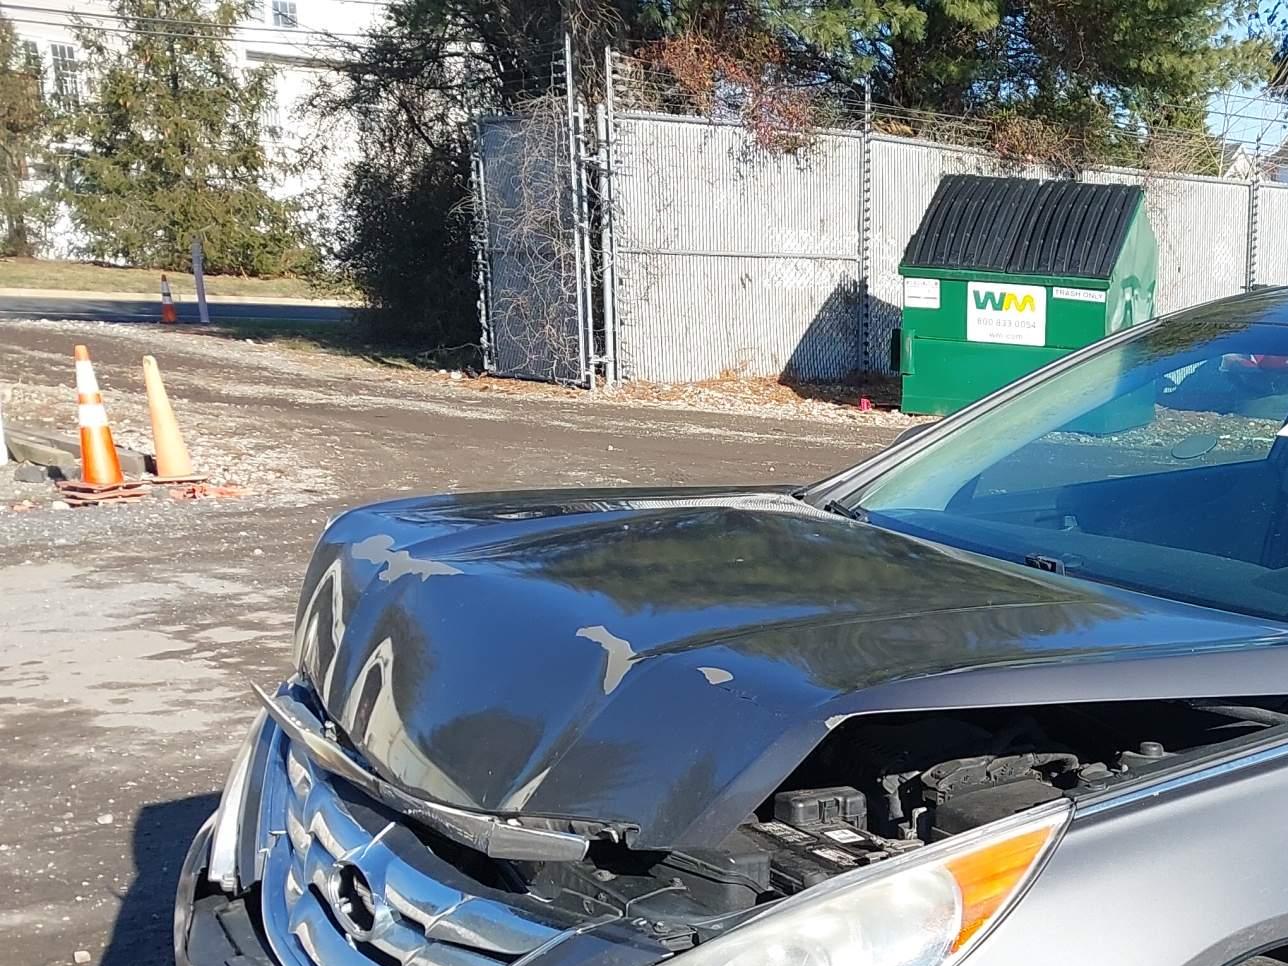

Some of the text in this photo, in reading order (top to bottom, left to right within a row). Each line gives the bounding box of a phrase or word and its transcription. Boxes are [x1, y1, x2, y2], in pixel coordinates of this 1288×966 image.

[1055, 288, 1103, 300] TRASH ONLY
[973, 289, 1036, 313] WM
[977, 318, 993, 326] 800
